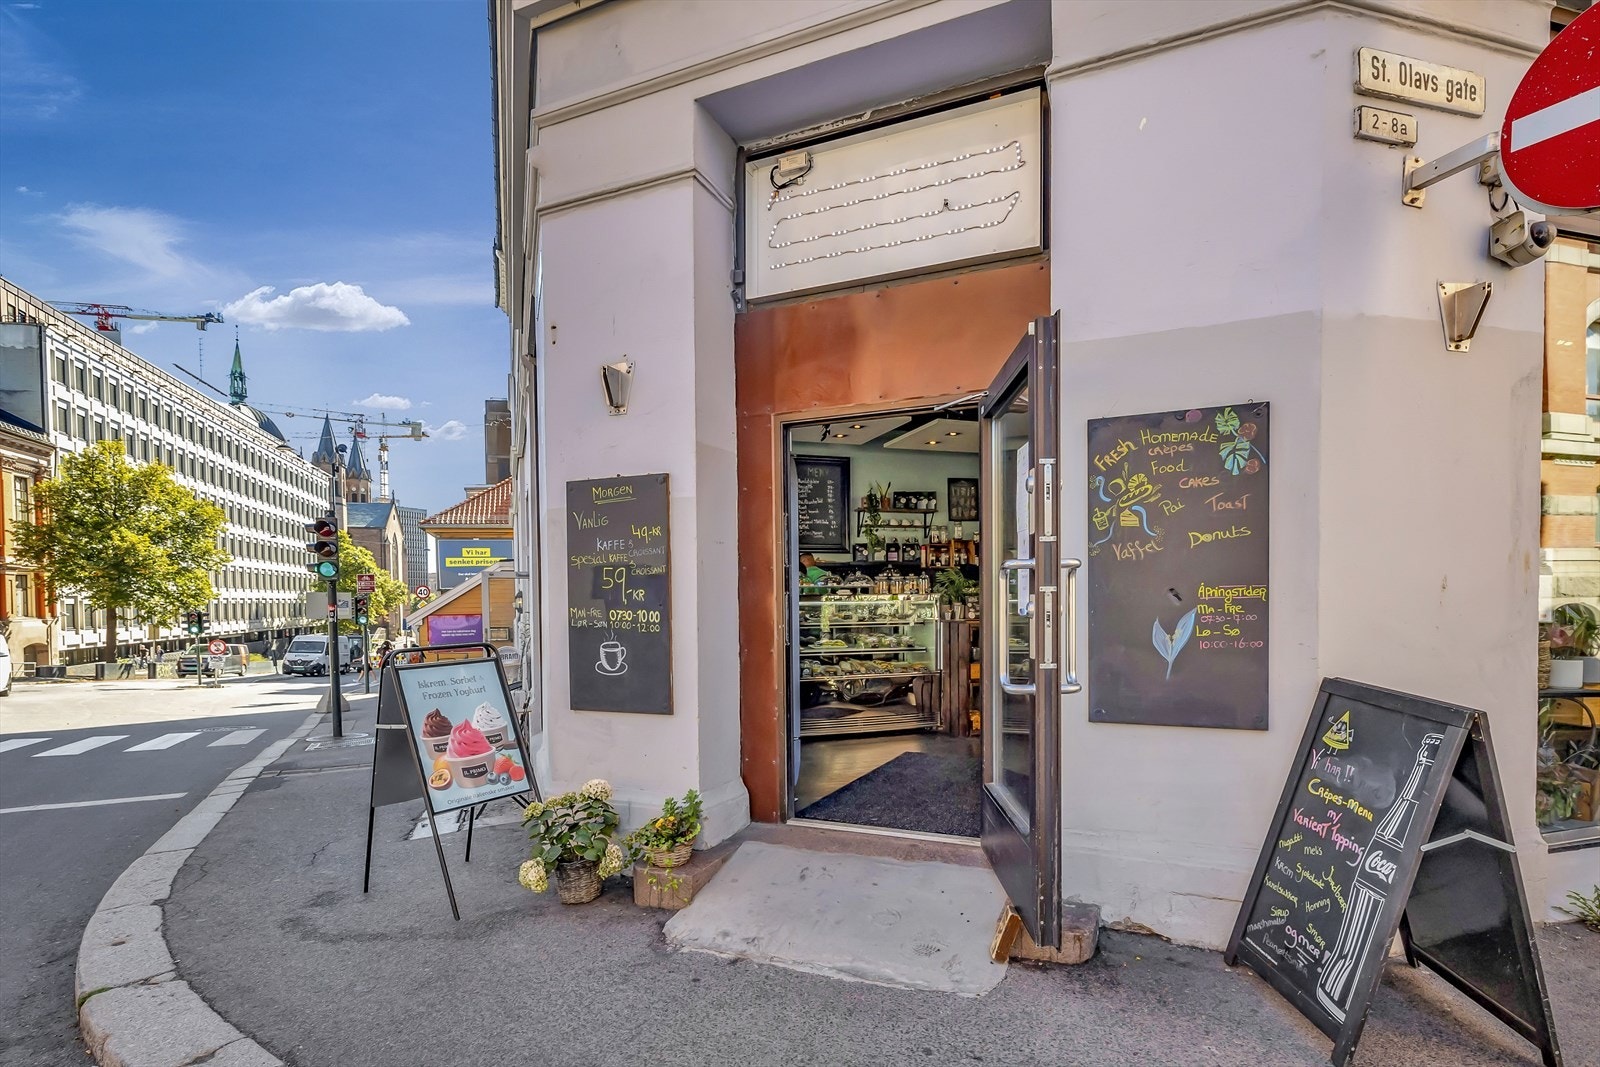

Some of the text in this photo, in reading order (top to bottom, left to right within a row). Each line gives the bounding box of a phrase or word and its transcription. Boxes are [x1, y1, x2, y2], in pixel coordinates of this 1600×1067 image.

[1371, 55, 1477, 103] St. Olavs gate
[1372, 113, 1408, 136] 2-8a
[596, 537, 625, 551] KAFFE
[1188, 525, 1252, 548] Donuts
[608, 553, 628, 563] KAFFE
[418, 588, 428, 596] 40
[422, 685, 487, 701] Frozen Yoghurt
[1310, 748, 1325, 770] Vi
